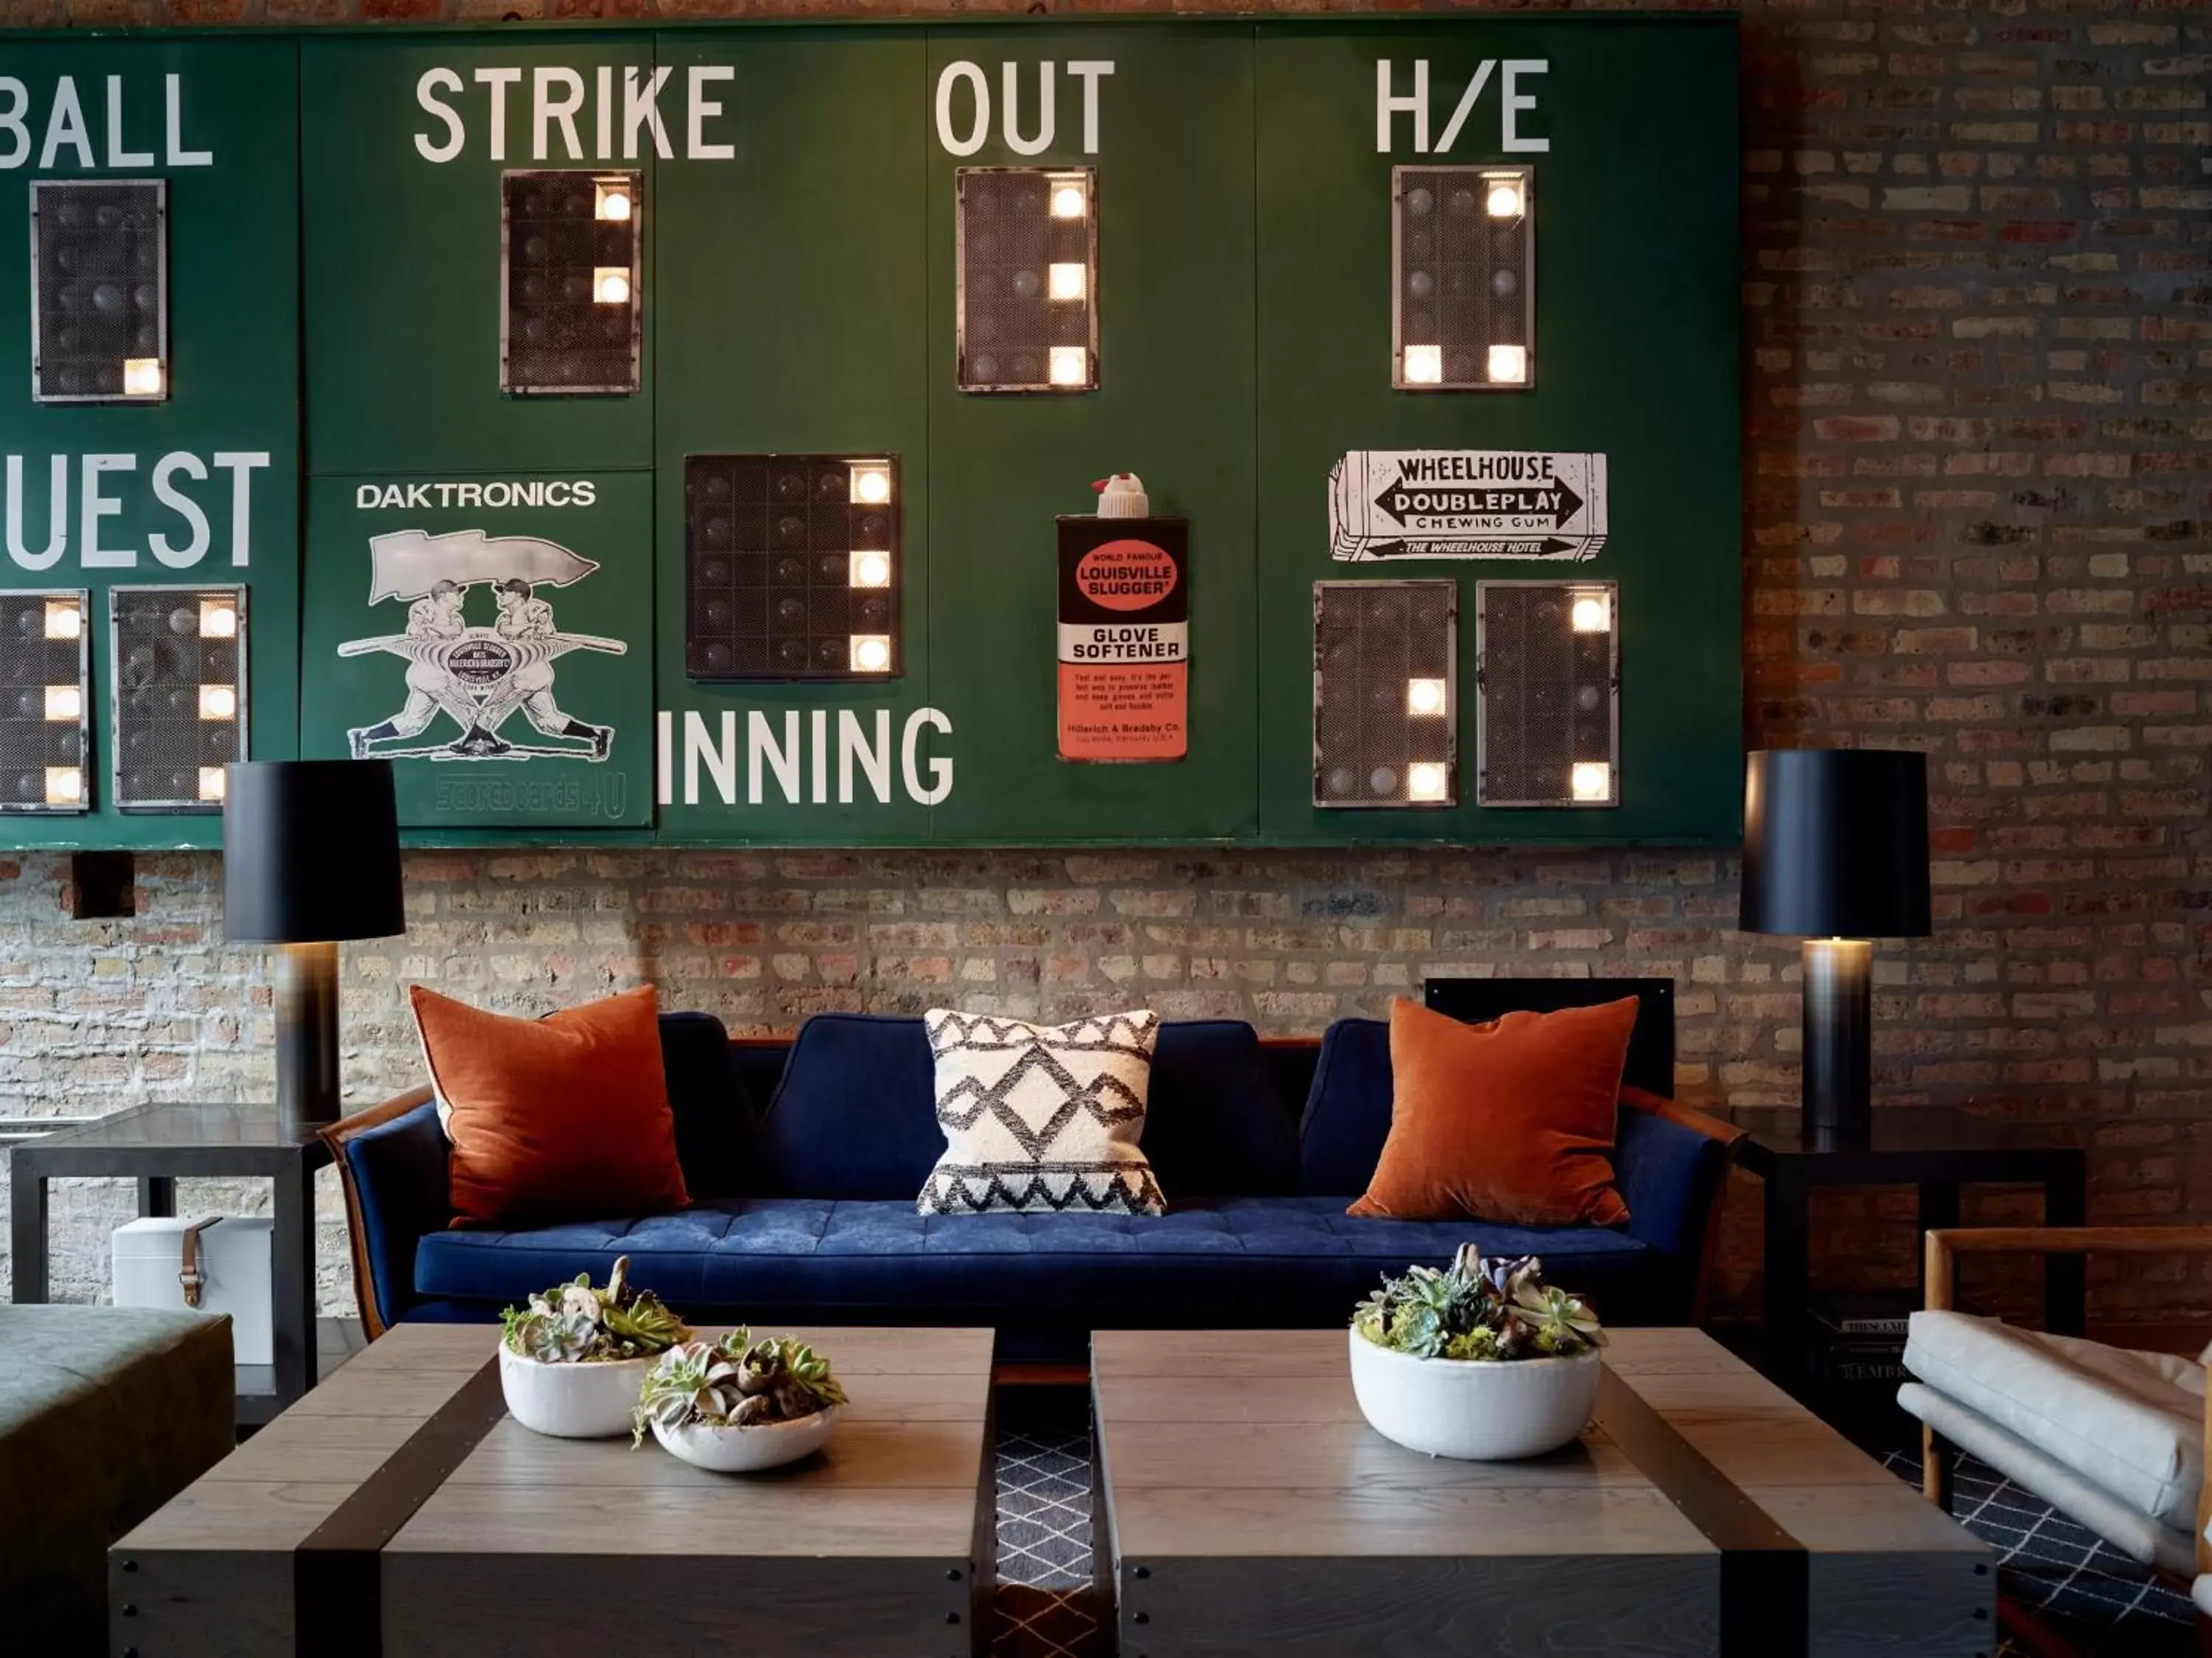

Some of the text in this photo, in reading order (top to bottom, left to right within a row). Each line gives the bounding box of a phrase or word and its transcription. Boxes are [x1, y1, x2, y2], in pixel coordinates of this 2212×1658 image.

[414, 66, 735, 163] STRIKE
[936, 60, 1115, 156] OUT
[1377, 59, 1549, 153] H/E
[0, 74, 212, 168] BALL
[1397, 456, 1554, 481] WHEELHOUSE
[356, 481, 597, 508] DAKTRONICS
[1394, 491, 1562, 512] DOUBLEPLAY
[6, 451, 270, 571] UEST
[1416, 517, 1549, 529] CHEWING GUM
[1092, 553, 1163, 563] WORLD FAMOUS
[1080, 566, 1172, 580] LOUISVILLE
[1088, 581, 1164, 595] SLUGGER
[1093, 628, 1158, 643] GLOVE
[1073, 643, 1180, 659] SOFTENER
[658, 707, 953, 806] INNING
